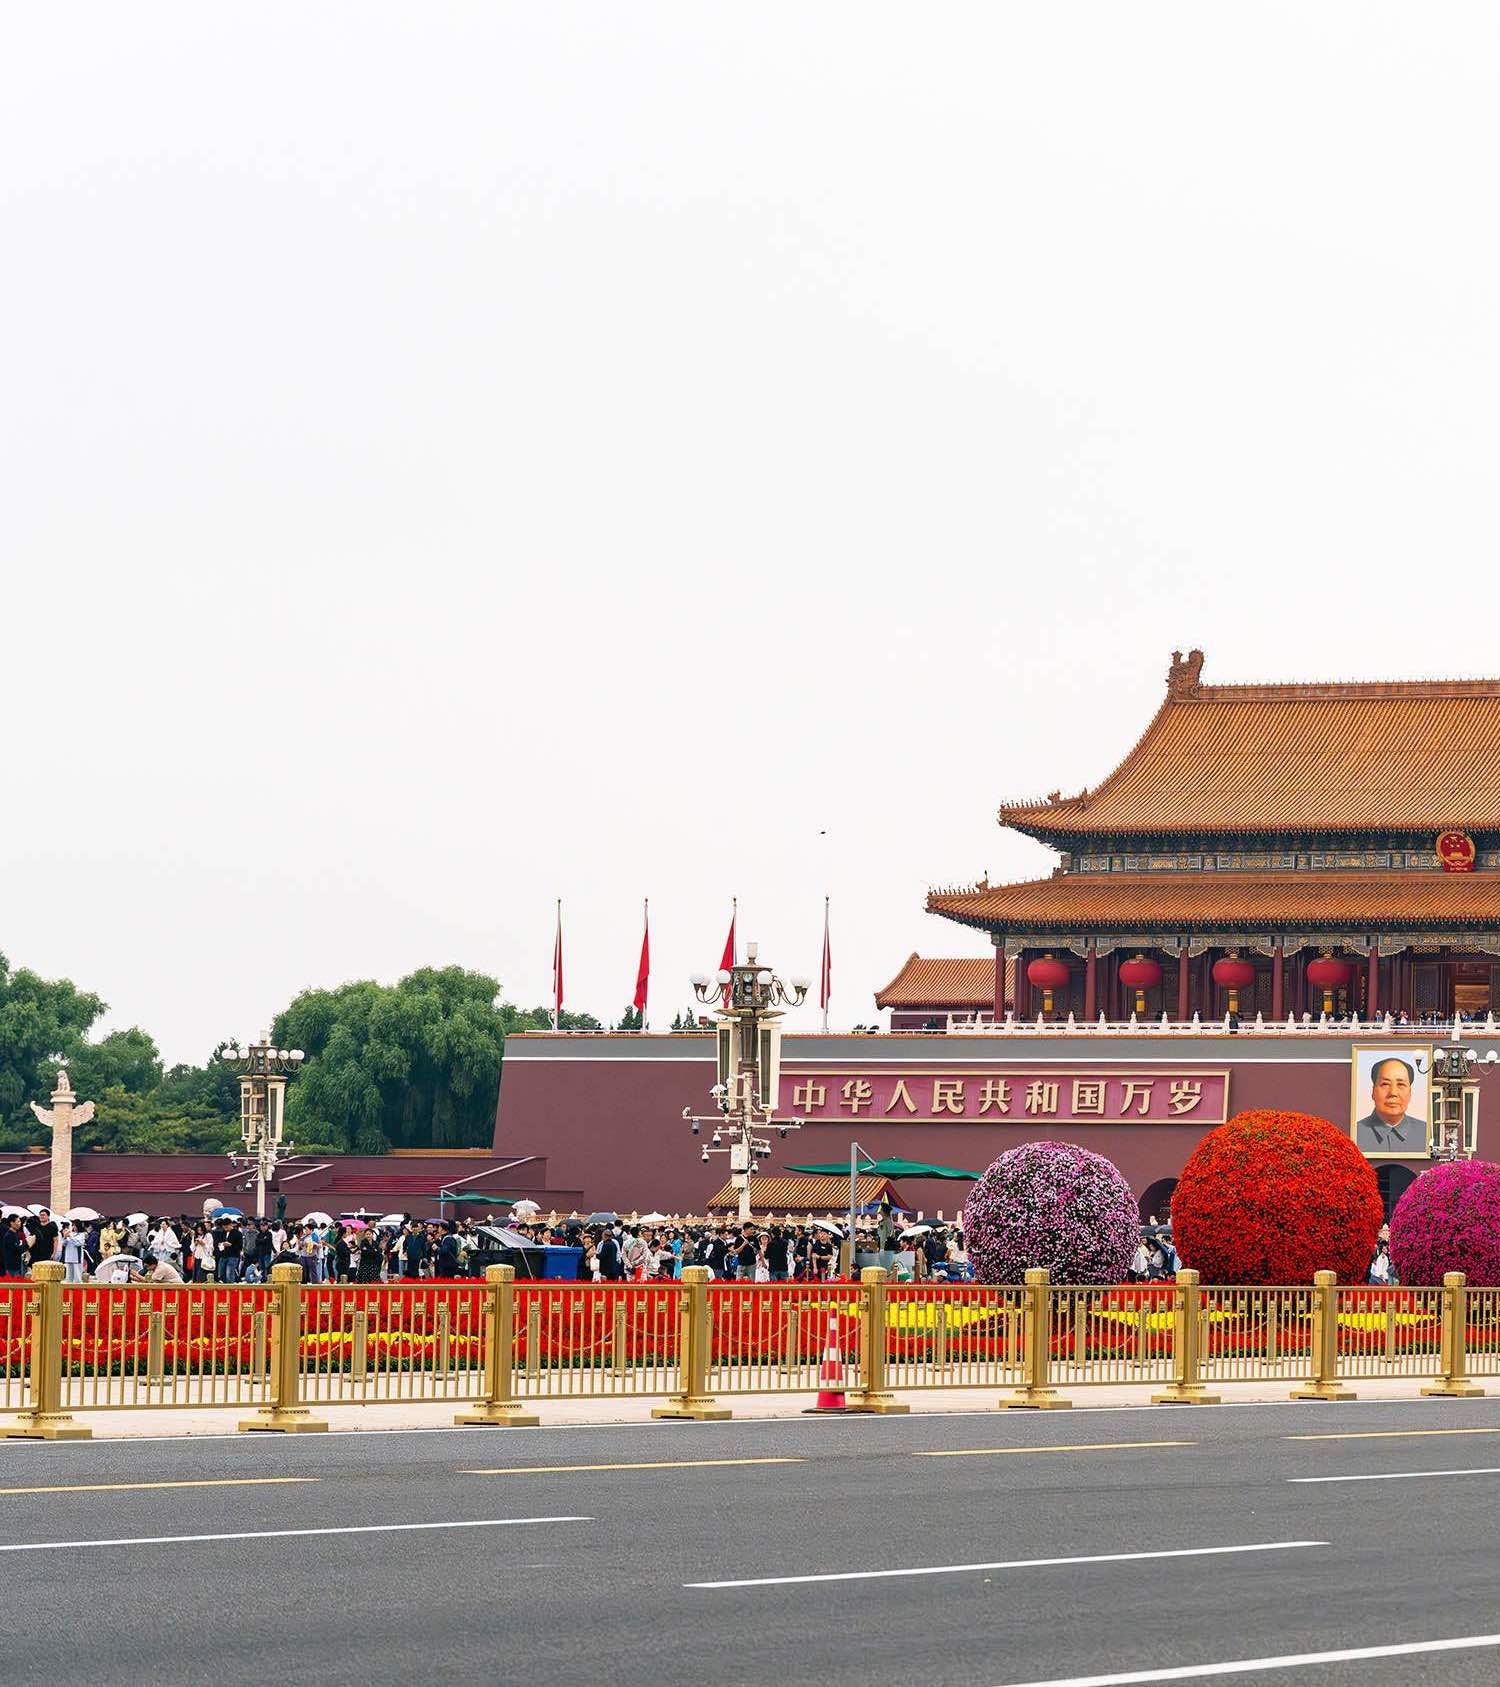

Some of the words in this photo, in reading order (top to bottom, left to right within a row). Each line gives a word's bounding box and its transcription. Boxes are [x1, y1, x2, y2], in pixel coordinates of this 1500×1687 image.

[793, 1079, 1203, 1115] 中华人民共和国万岁
